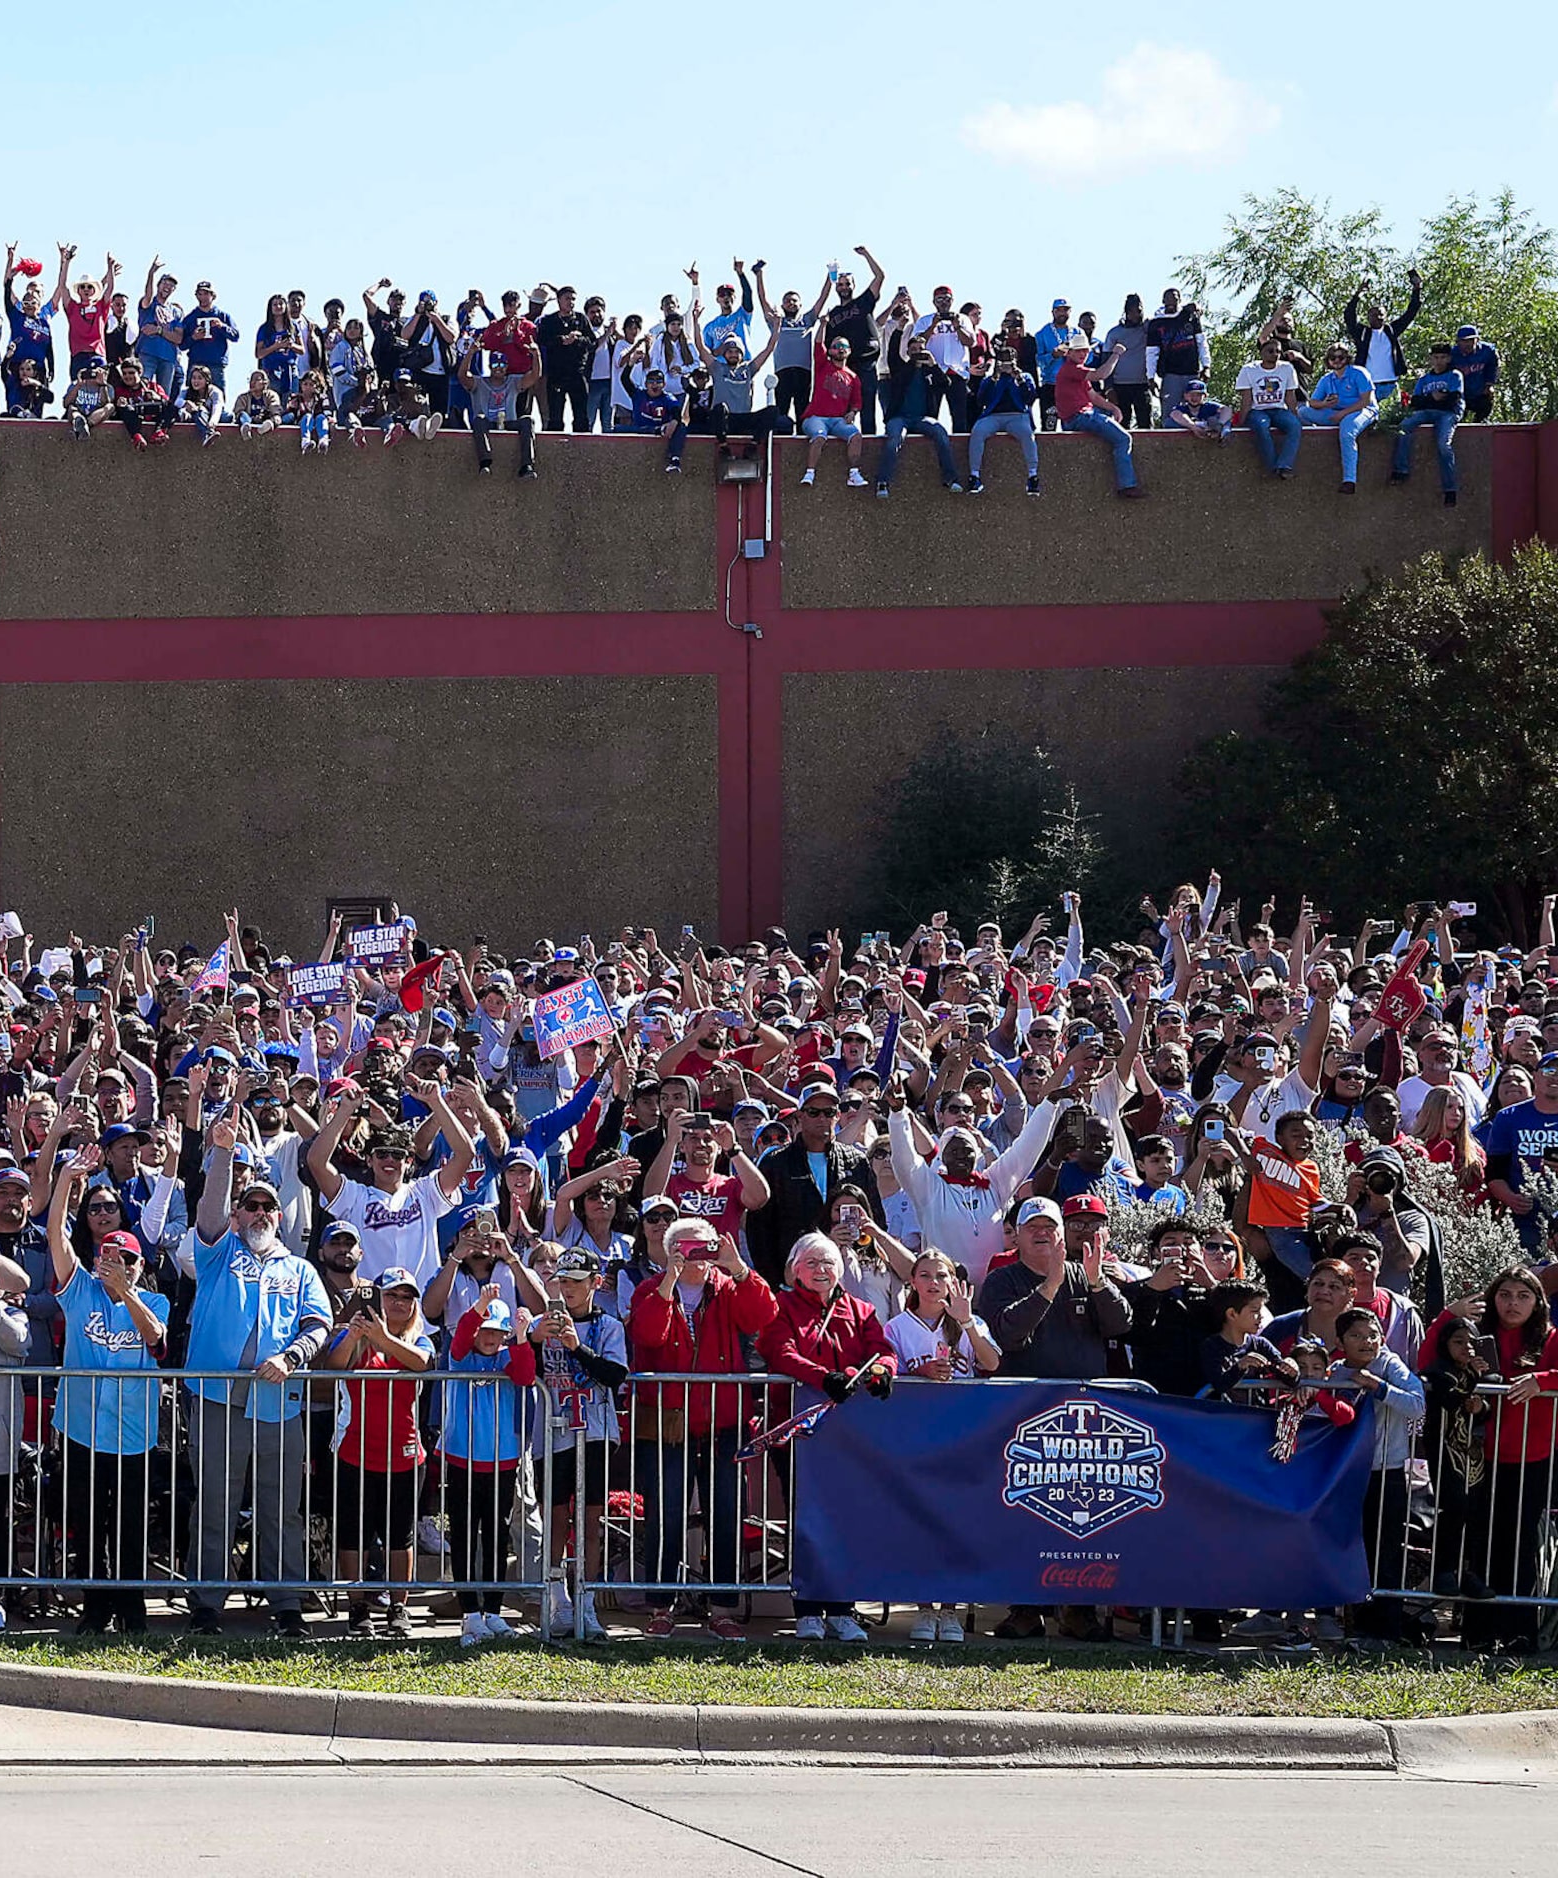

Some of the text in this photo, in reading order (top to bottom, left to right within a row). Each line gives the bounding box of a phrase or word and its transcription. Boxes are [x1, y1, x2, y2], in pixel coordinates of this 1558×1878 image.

[196, 317, 221, 338] T
[349, 925, 405, 945] LONE STAR
[354, 940, 401, 957] LEGENDS
[287, 962, 344, 985] LONE STAR
[294, 976, 342, 996] LEGENDS
[1389, 996, 1408, 1019] TX
[1077, 1197, 1092, 1209] T
[559, 1388, 594, 1431] T
[1068, 1404, 1095, 1434] T
[1043, 1437, 1124, 1460] WORLD
[1013, 1462, 1155, 1490] CHAMPIONS
[1048, 1488, 1116, 1502] 20 23
[1039, 1552, 1121, 1561] PRESENTED BY
[1040, 1562, 1121, 1589] Coca-Cola
